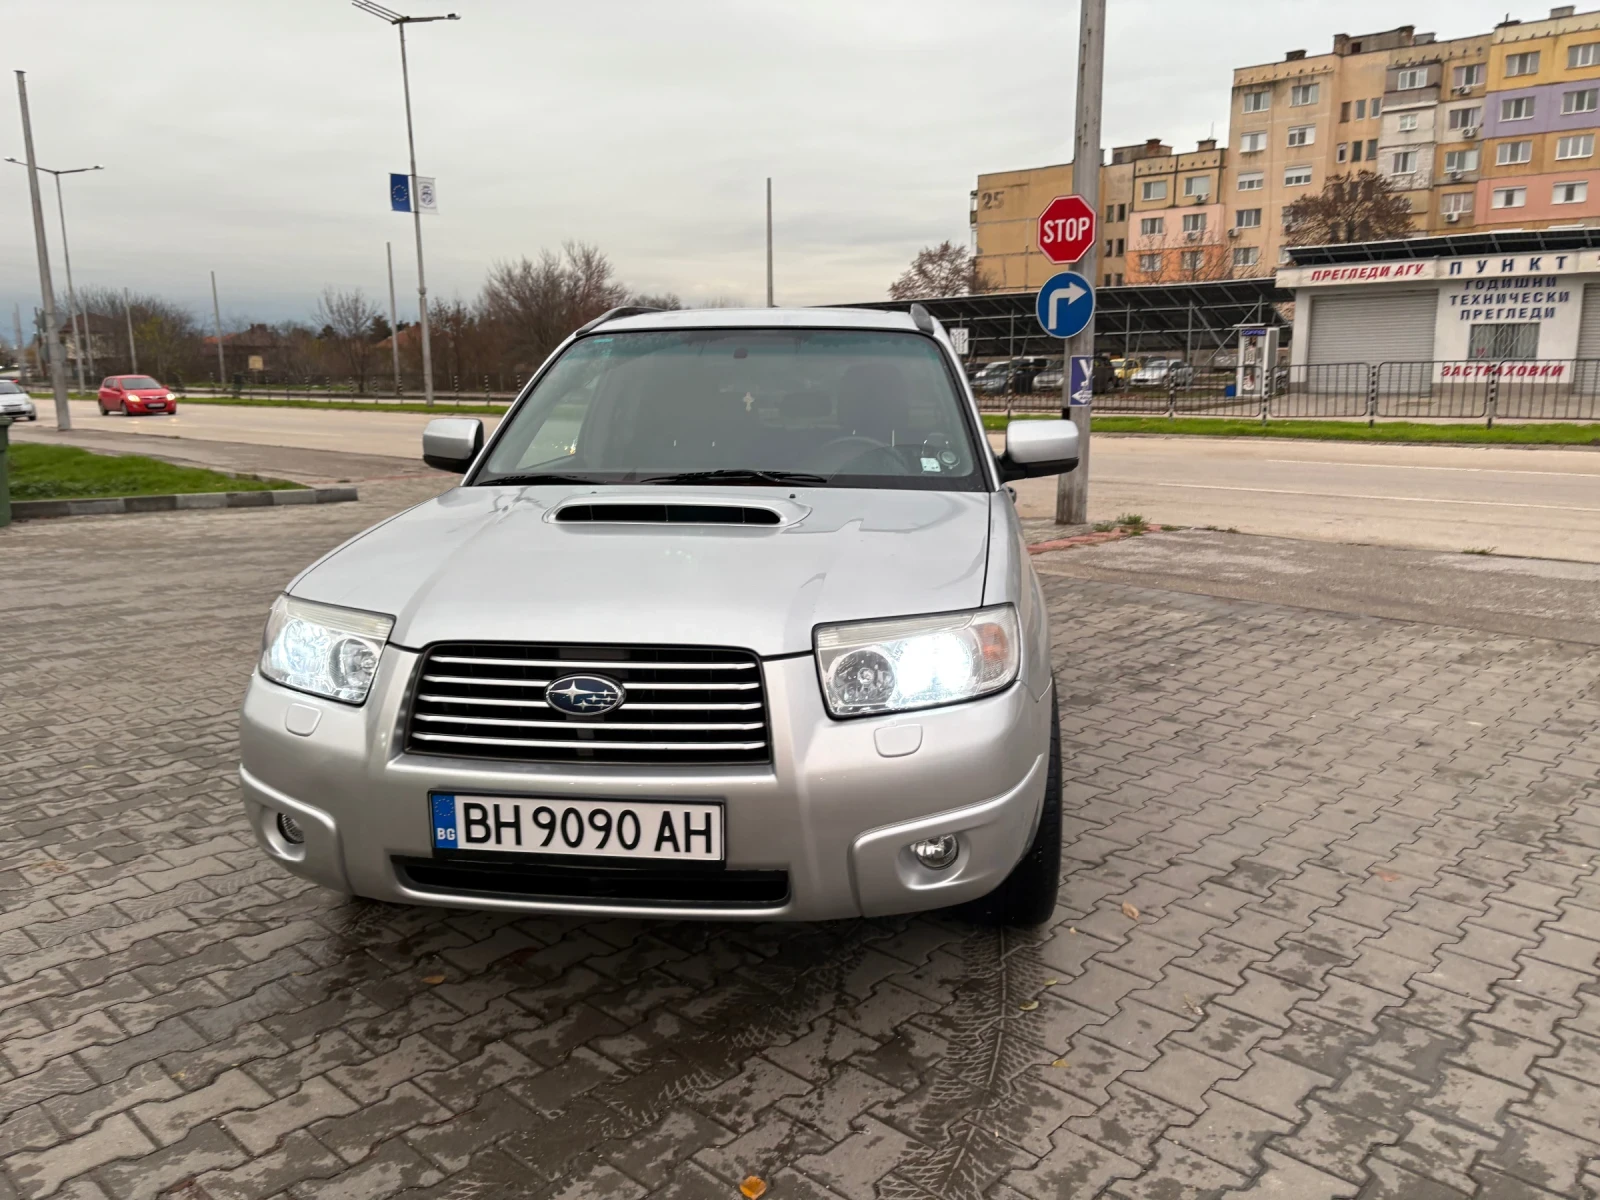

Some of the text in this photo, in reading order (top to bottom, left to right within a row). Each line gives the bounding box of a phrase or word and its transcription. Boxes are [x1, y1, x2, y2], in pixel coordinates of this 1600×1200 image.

[982, 191, 1005, 210] 25
[1043, 217, 1090, 243] STOP
[1311, 264, 1425, 282] ПРЕГЛЕДИ АГУ
[1449, 256, 1568, 275] ПУНКТ
[1464, 276, 1557, 291] ГОДИШНИ
[1450, 291, 1570, 306] ТЕХНИЧЕСКИ
[1460, 307, 1556, 321] ПРЕГЛЕДИ
[436, 827, 456, 841] BG
[463, 802, 712, 854] BH 9090 AH
